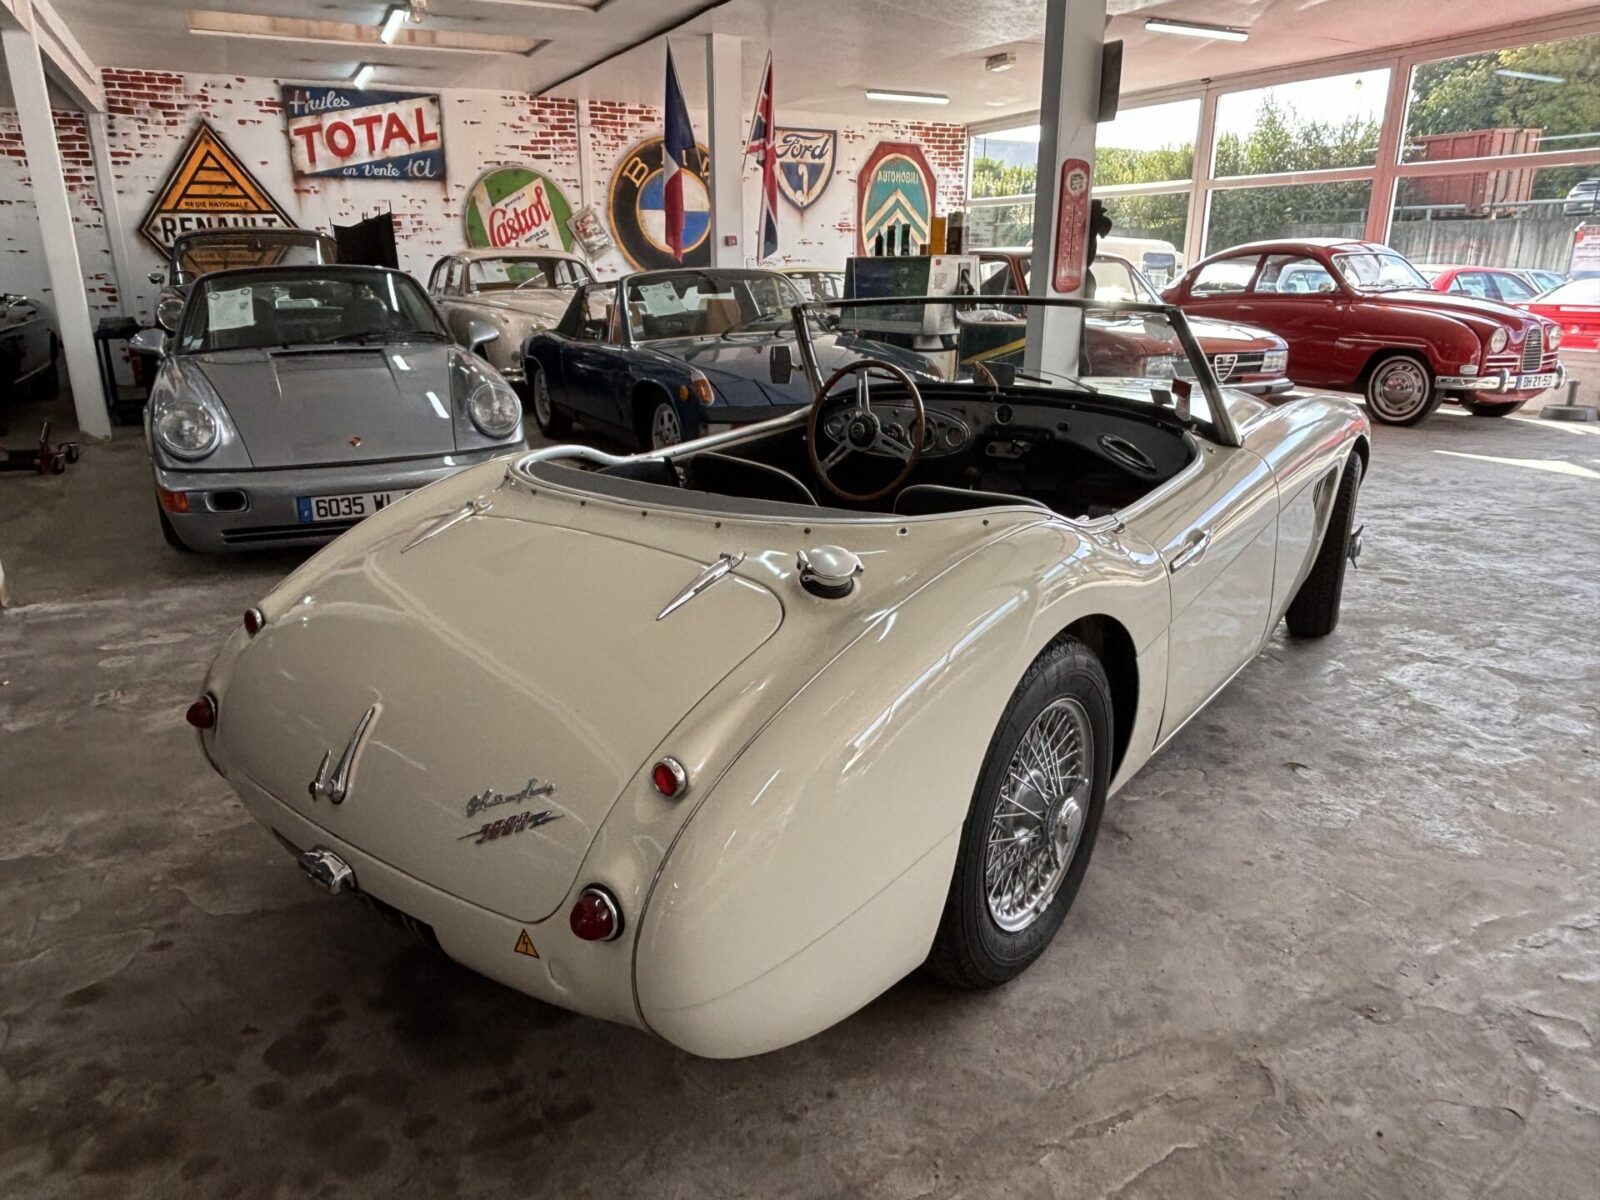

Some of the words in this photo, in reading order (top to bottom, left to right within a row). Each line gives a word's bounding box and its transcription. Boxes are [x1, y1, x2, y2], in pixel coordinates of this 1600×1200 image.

[289, 90, 351, 114] Huiles
[293, 107, 438, 164] TOTAL
[776, 133, 832, 160] Ford
[362, 162, 400, 177] Vente
[488, 185, 551, 248] Castrol
[315, 496, 365, 518] 6035
[373, 493, 392, 512] W
